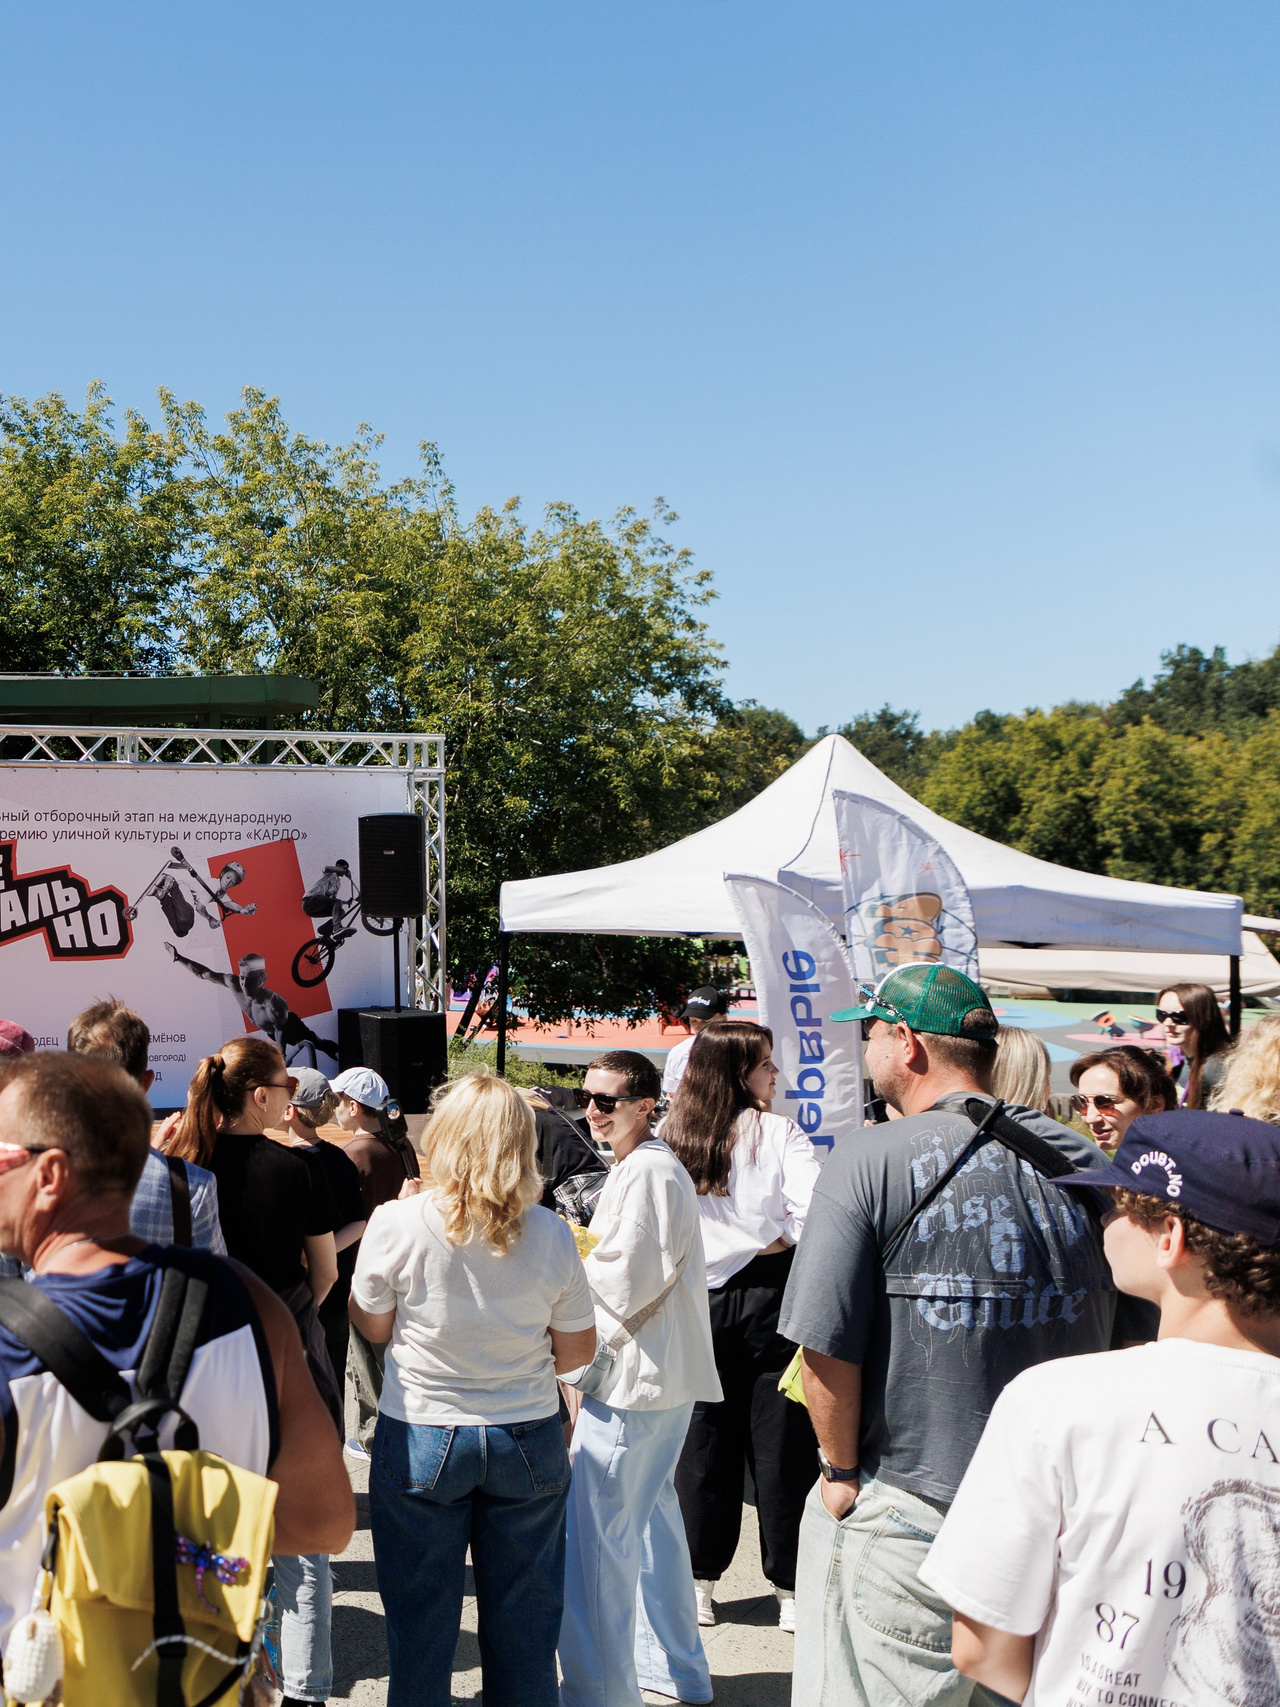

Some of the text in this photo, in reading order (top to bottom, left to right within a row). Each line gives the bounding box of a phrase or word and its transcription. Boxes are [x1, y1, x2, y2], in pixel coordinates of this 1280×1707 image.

[34, 809, 120, 825] отборочный
[124, 811, 155, 823] этап
[159, 811, 175, 823] на
[178, 811, 292, 826] международную
[52, 827, 110, 843] уличной
[114, 829, 179, 843] культуры
[183, 830, 191, 841] и
[195, 830, 242, 843] спорта
[246, 828, 308, 843] «КАРДО»
[52, 899, 121, 948] НО
[32, 1036, 59, 1048] ОДЕЦ
[148, 1053, 187, 1063] ОВГОРОД)
[1138, 1411, 1280, 1465] A CA
[1143, 1557, 1187, 1600] 19
[1095, 1602, 1140, 1650] 87
[1098, 1664, 1142, 1689] GREAT
[1096, 1687, 1114, 1705] TO
